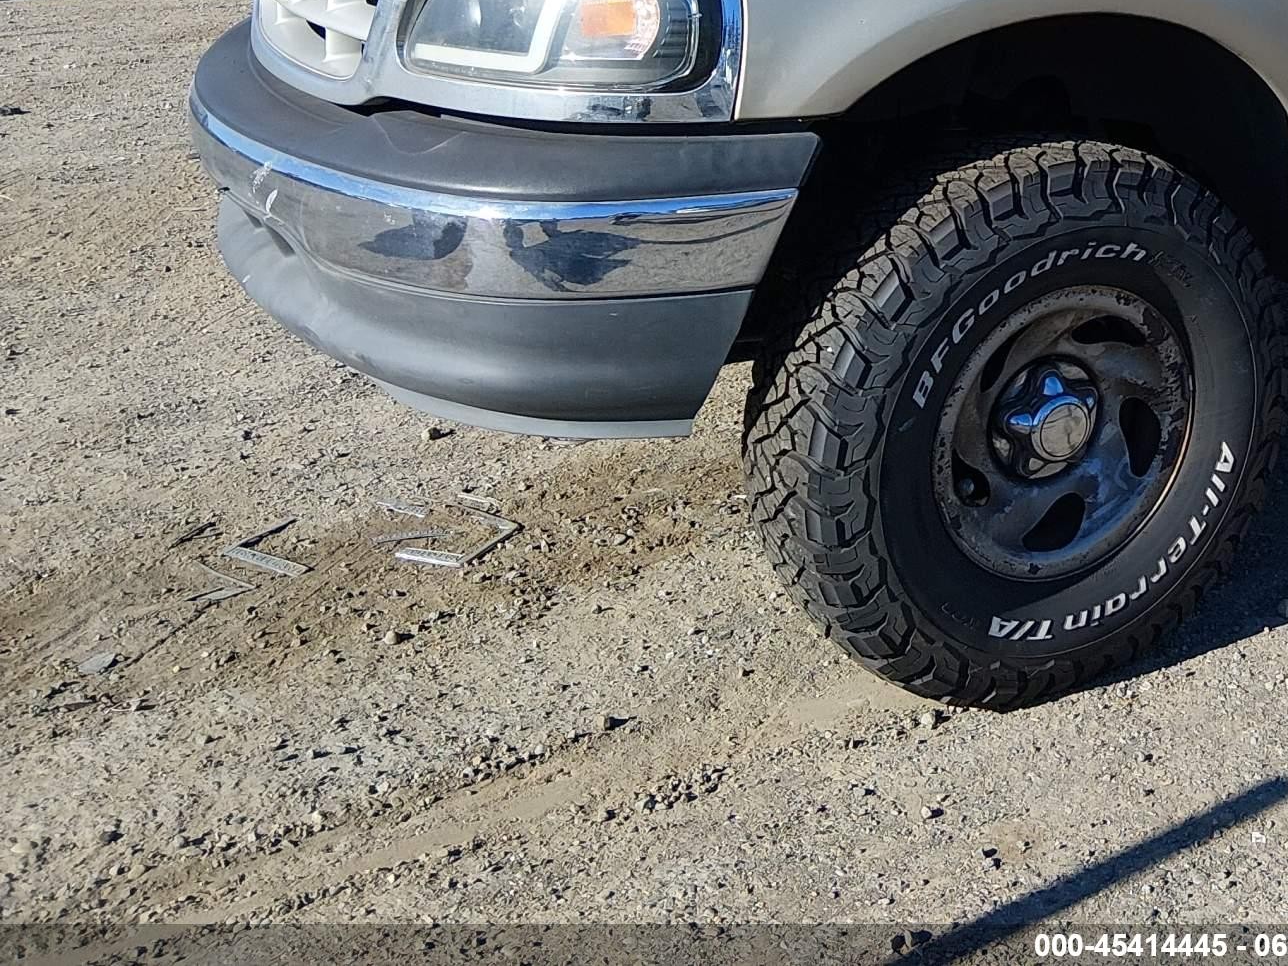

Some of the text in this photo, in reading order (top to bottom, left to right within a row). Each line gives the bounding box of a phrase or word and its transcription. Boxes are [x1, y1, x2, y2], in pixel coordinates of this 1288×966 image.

[912, 241, 1147, 409] BFGoodrich
[988, 441, 1236, 641] All-Terrain T/A
